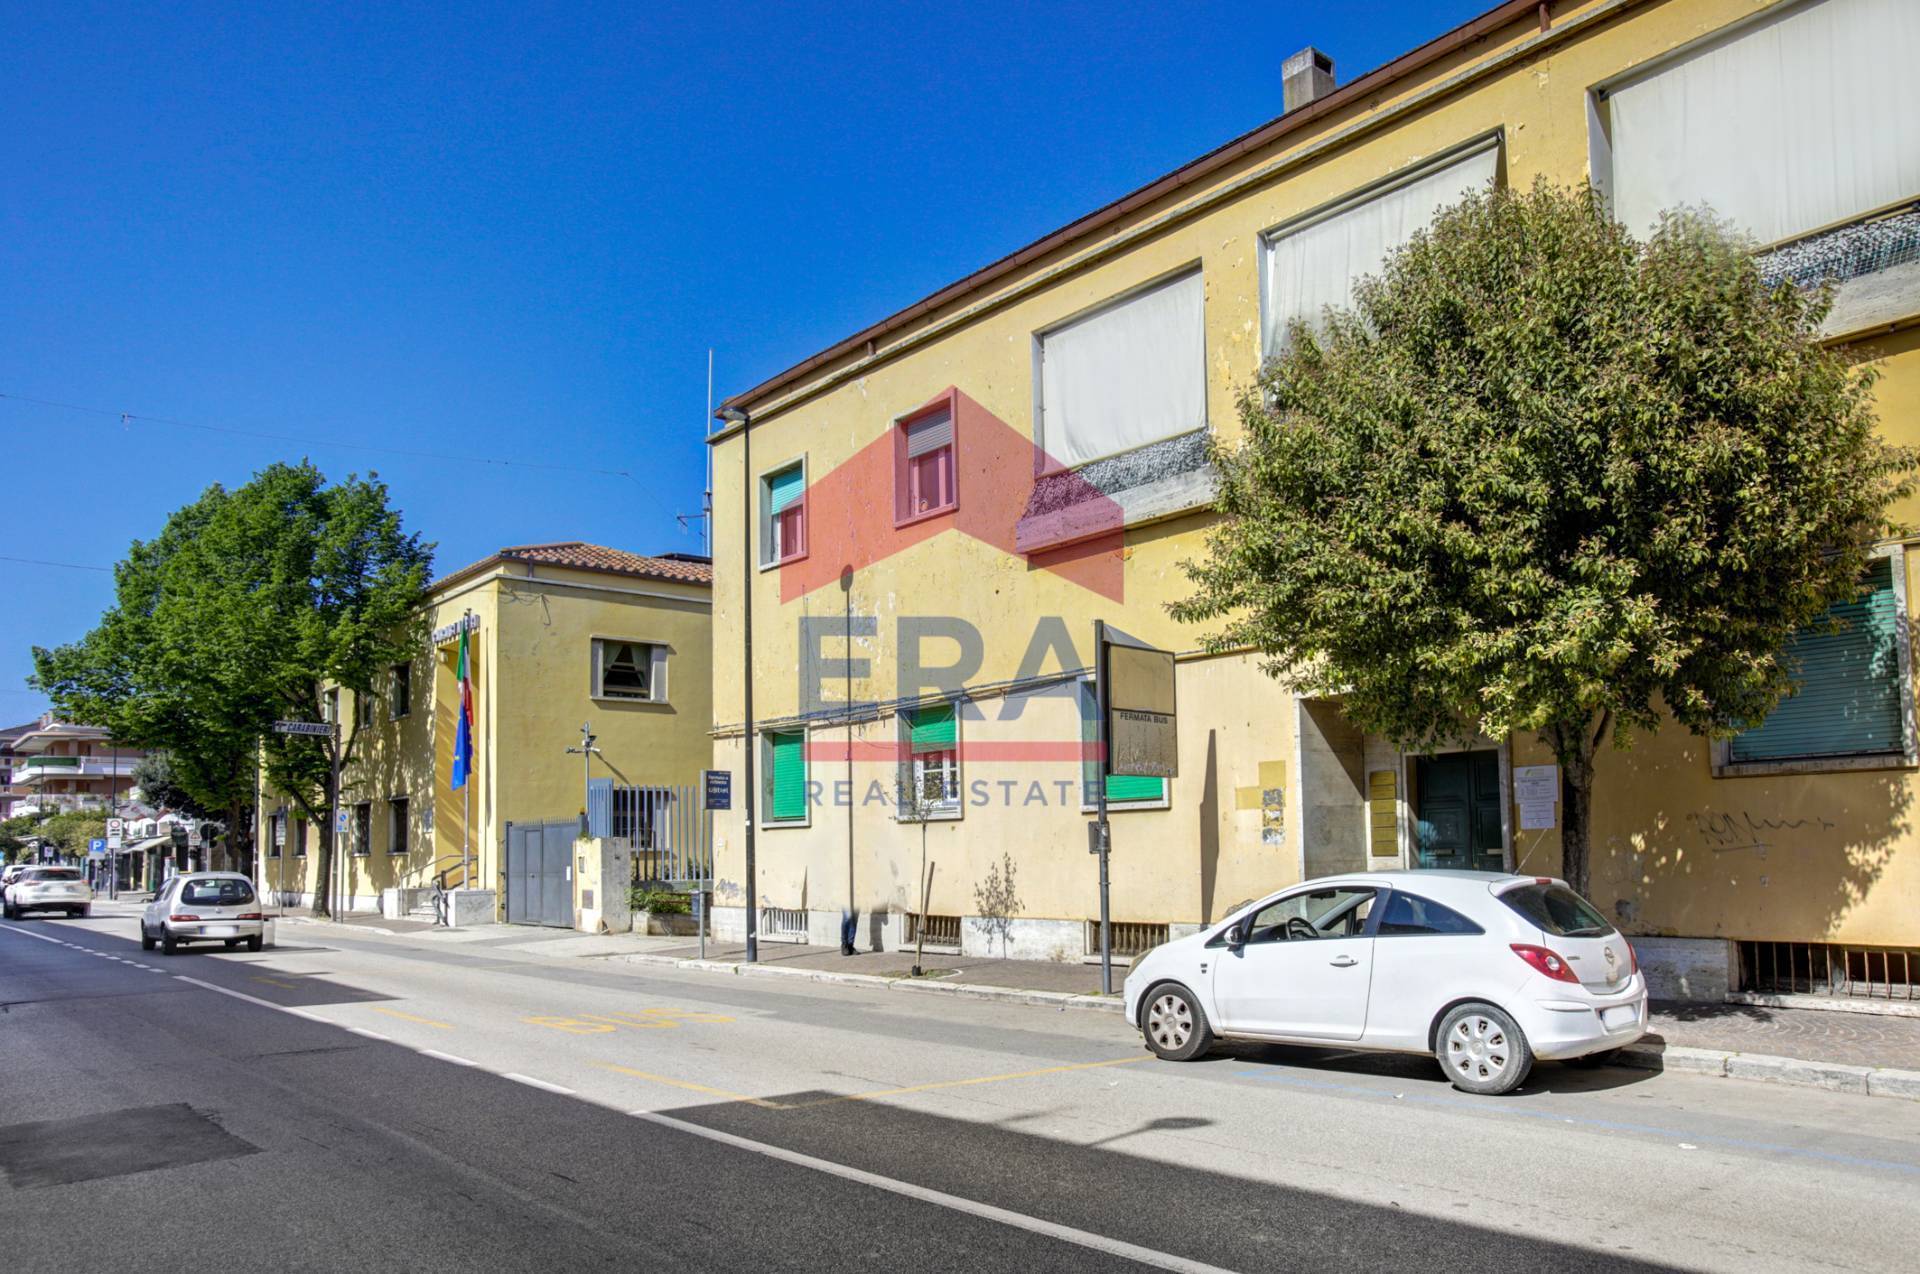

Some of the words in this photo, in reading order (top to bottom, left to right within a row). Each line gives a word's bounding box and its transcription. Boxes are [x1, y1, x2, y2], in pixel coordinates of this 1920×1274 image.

[1120, 711, 1152, 722] FERMATA
[1153, 715, 1169, 724] BUS
[287, 722, 330, 734] CARABINIERI
[93, 840, 103, 851] P
[520, 1008, 737, 1034] BUS
